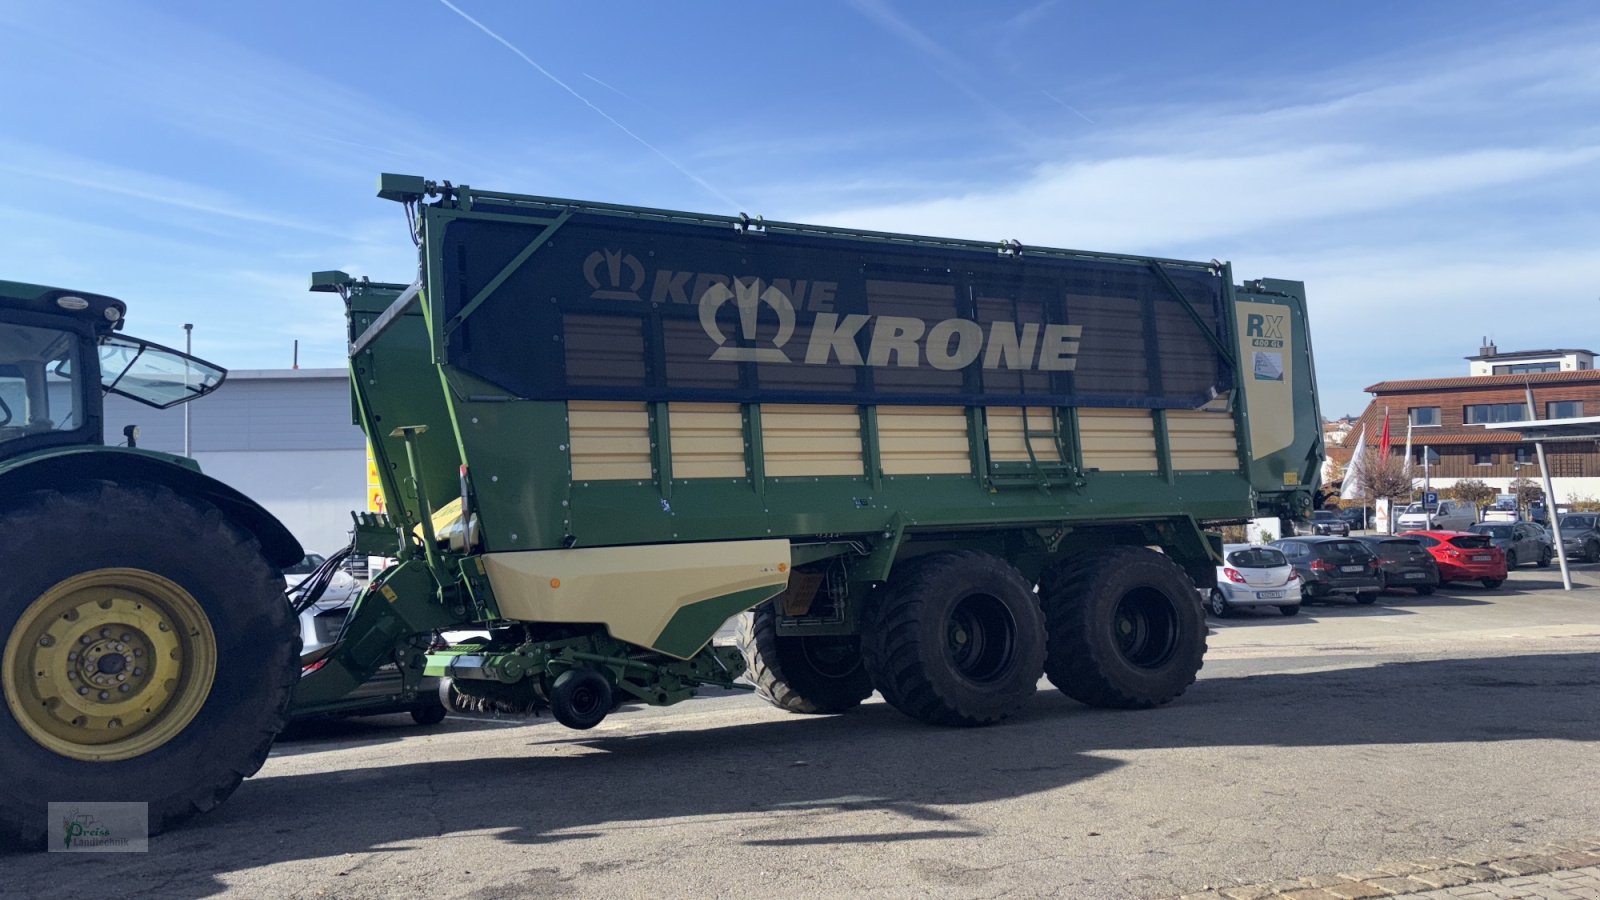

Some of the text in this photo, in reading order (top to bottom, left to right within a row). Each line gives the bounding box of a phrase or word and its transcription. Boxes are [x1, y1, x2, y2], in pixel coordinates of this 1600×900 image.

[1247, 313, 1283, 338] RX
[804, 312, 1083, 371] KRONE
[1428, 494, 1435, 502] P
